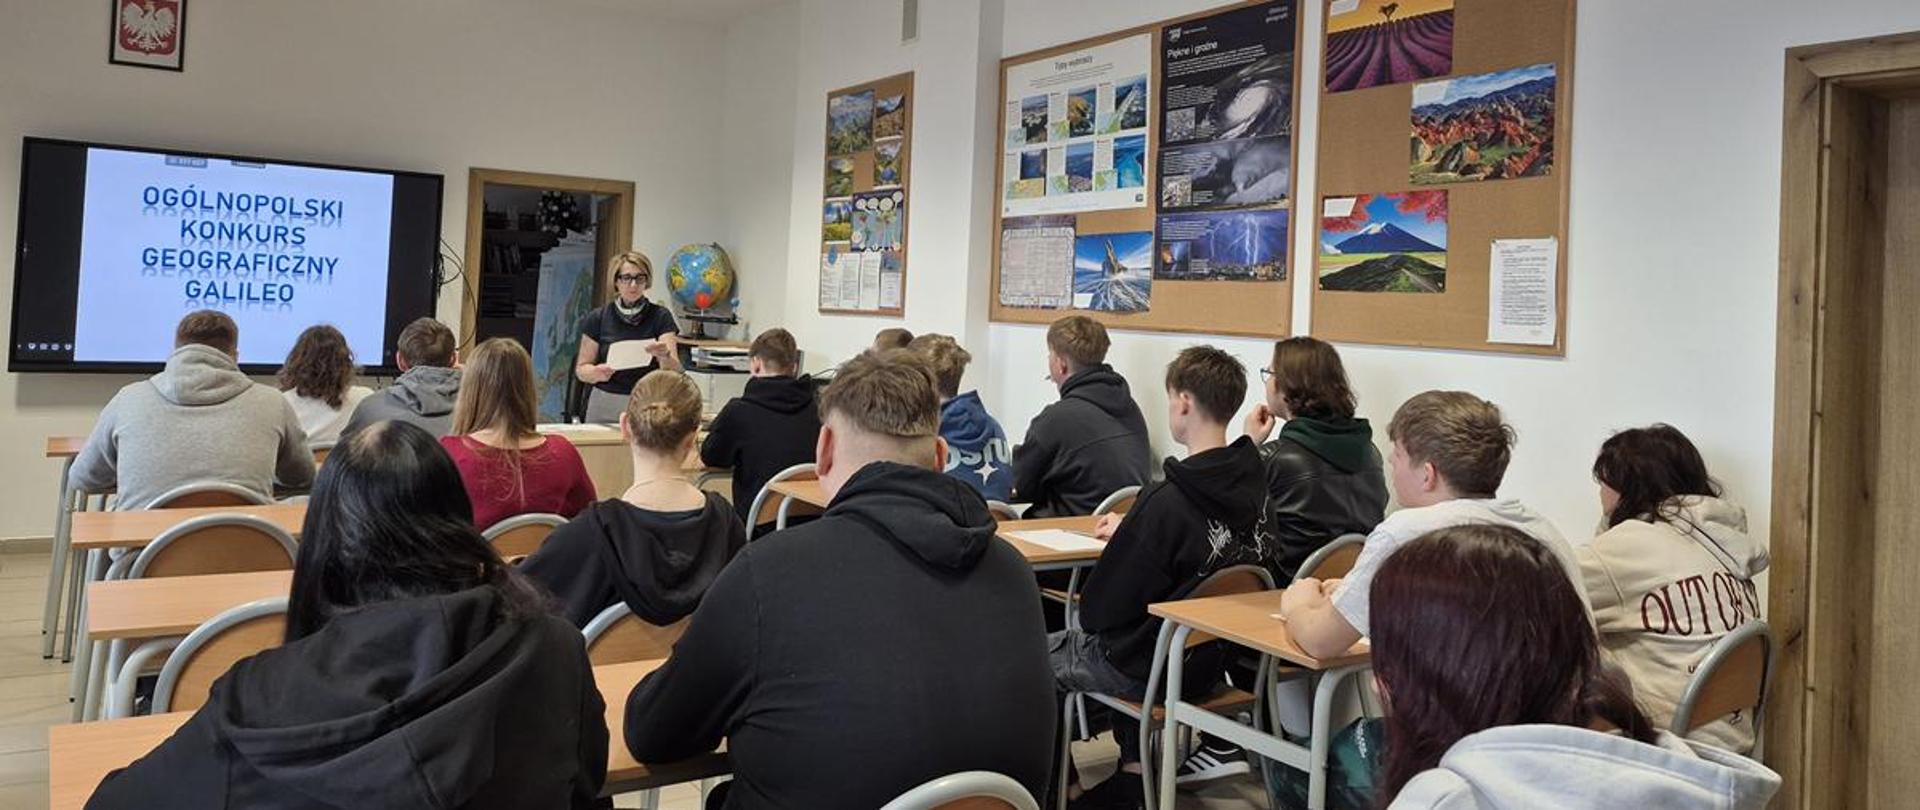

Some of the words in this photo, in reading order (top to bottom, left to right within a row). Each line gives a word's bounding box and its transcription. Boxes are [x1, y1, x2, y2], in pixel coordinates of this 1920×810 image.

[143, 184, 344, 219] OGÓLNOPOLSKI
[180, 219, 307, 245] KONKURS
[142, 247, 340, 276] GEOGRAFICZNY
[185, 280, 294, 303] GALILEO
[1640, 575, 1712, 636] OUT
